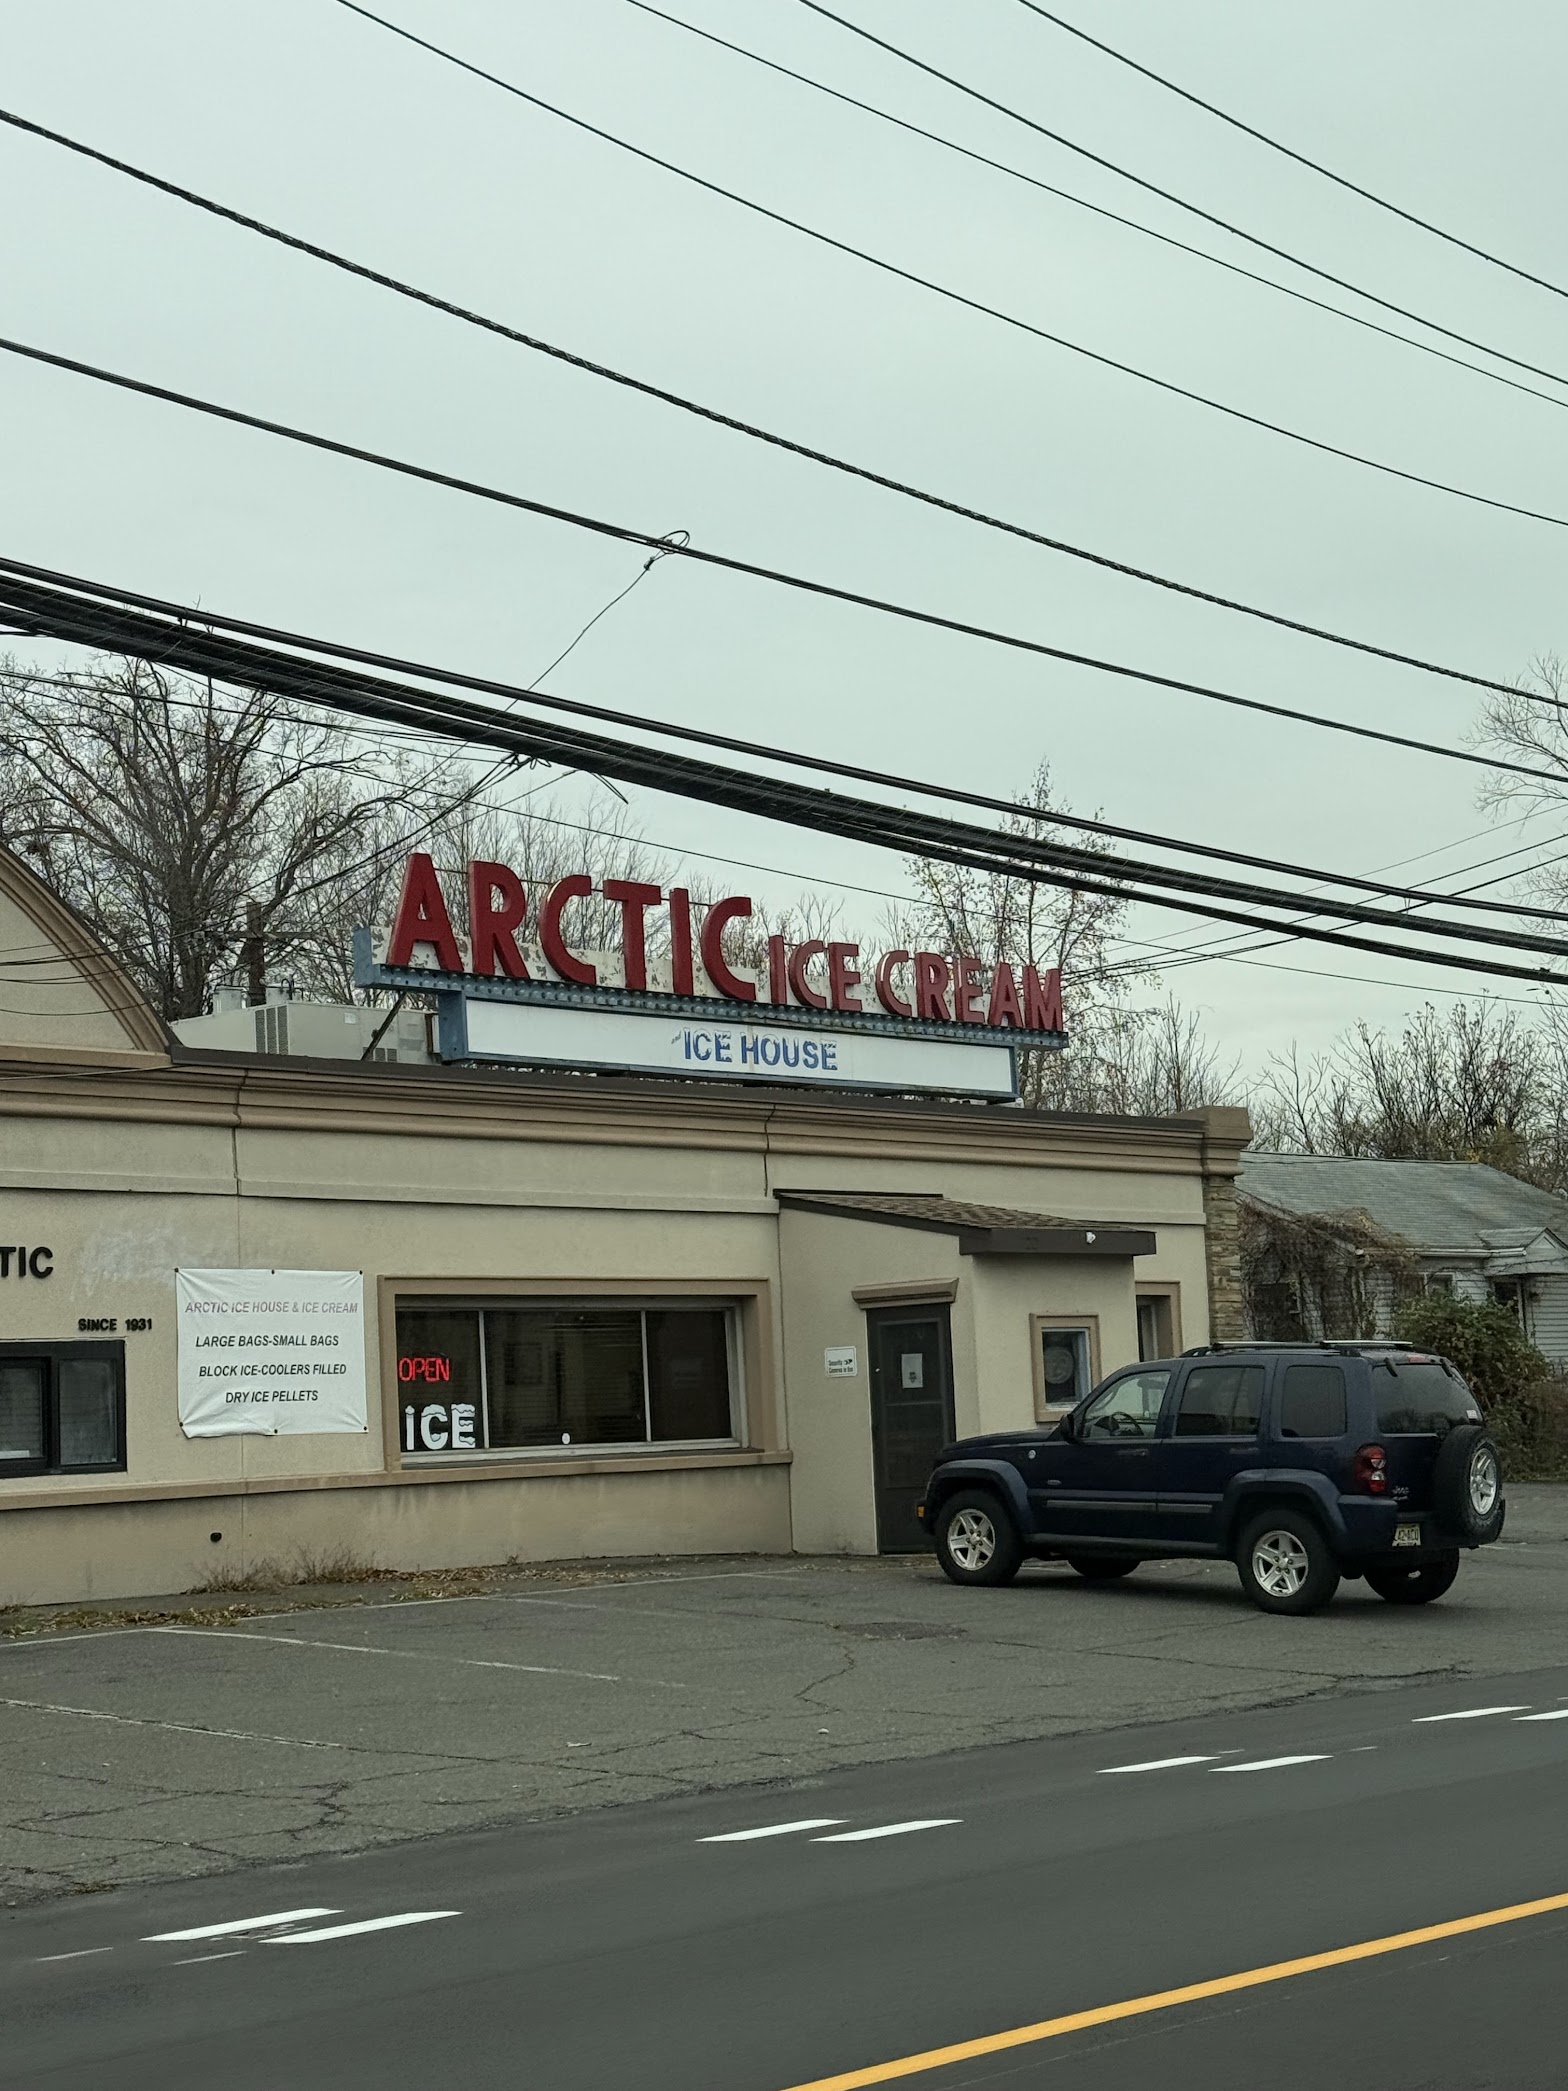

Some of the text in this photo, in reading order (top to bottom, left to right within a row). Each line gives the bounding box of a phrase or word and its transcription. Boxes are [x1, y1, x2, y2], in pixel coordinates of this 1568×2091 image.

[386, 852, 1064, 1031] ARCTIC ICE CREAM
[683, 1027, 838, 1071] ICE HOUSE
[185, 1301, 358, 1313] ARCTIC ICE HOUSE & ICE CREAM
[78, 1318, 153, 1332] SINCE 1931
[195, 1335, 339, 1348] LARGE BAGS-SMALL BAGS
[199, 1364, 347, 1377] BLOCK ICE-COOLERS FILLED
[399, 1357, 450, 1382] OPEN
[225, 1390, 319, 1404] DRY ICE PELLETS
[404, 1403, 476, 1451] ICE
